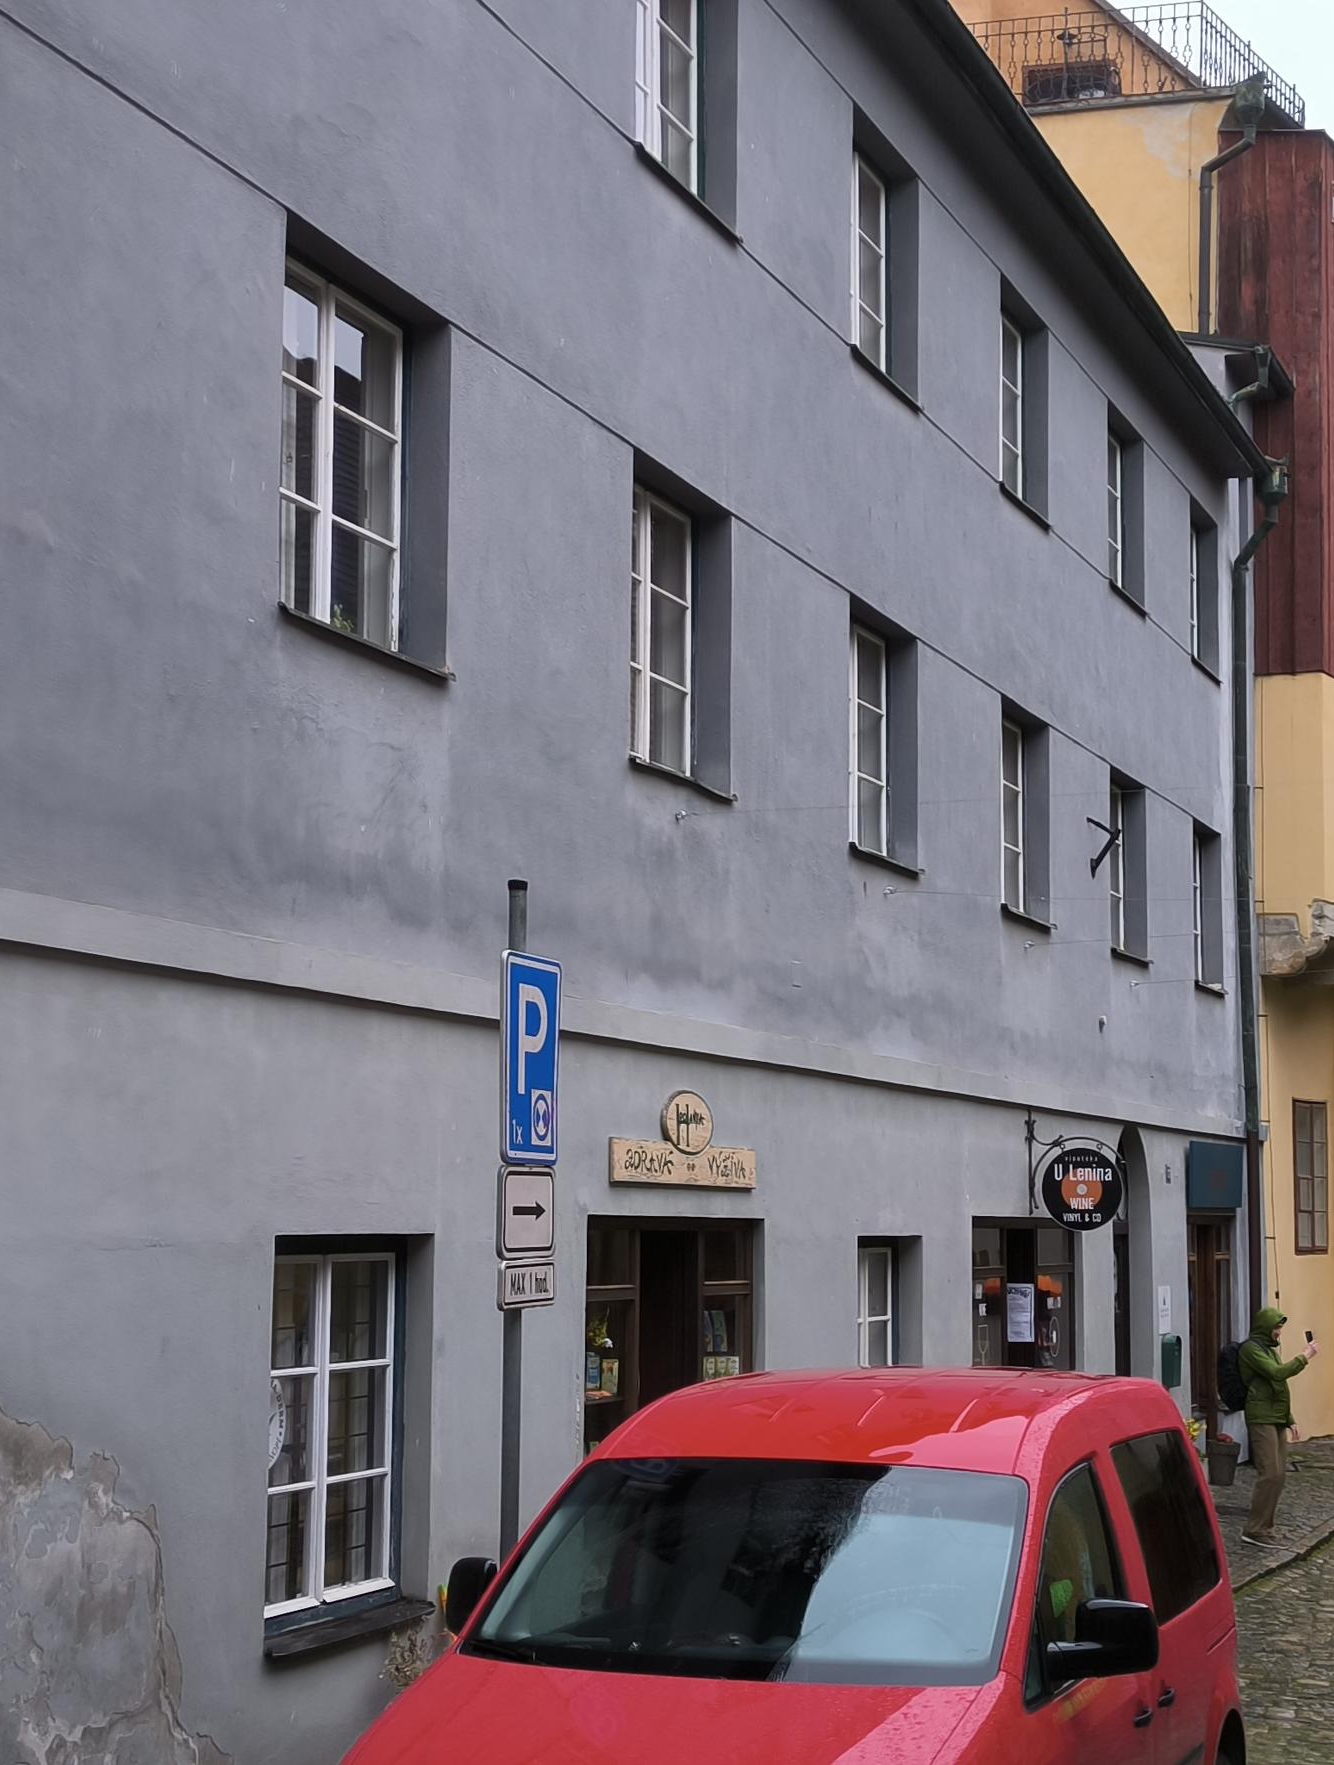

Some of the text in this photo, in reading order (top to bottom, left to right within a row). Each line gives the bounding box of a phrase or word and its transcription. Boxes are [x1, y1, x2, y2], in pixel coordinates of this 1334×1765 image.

[518, 983, 548, 1095] P
[512, 1119, 523, 1144] 1x
[1054, 1163, 1112, 1181] U Lenina
[1069, 1197, 1094, 1210] WINE
[1063, 1213, 1082, 1222] VINYL
[509, 1271, 526, 1296] MAX
[529, 1271, 533, 1295] 1
